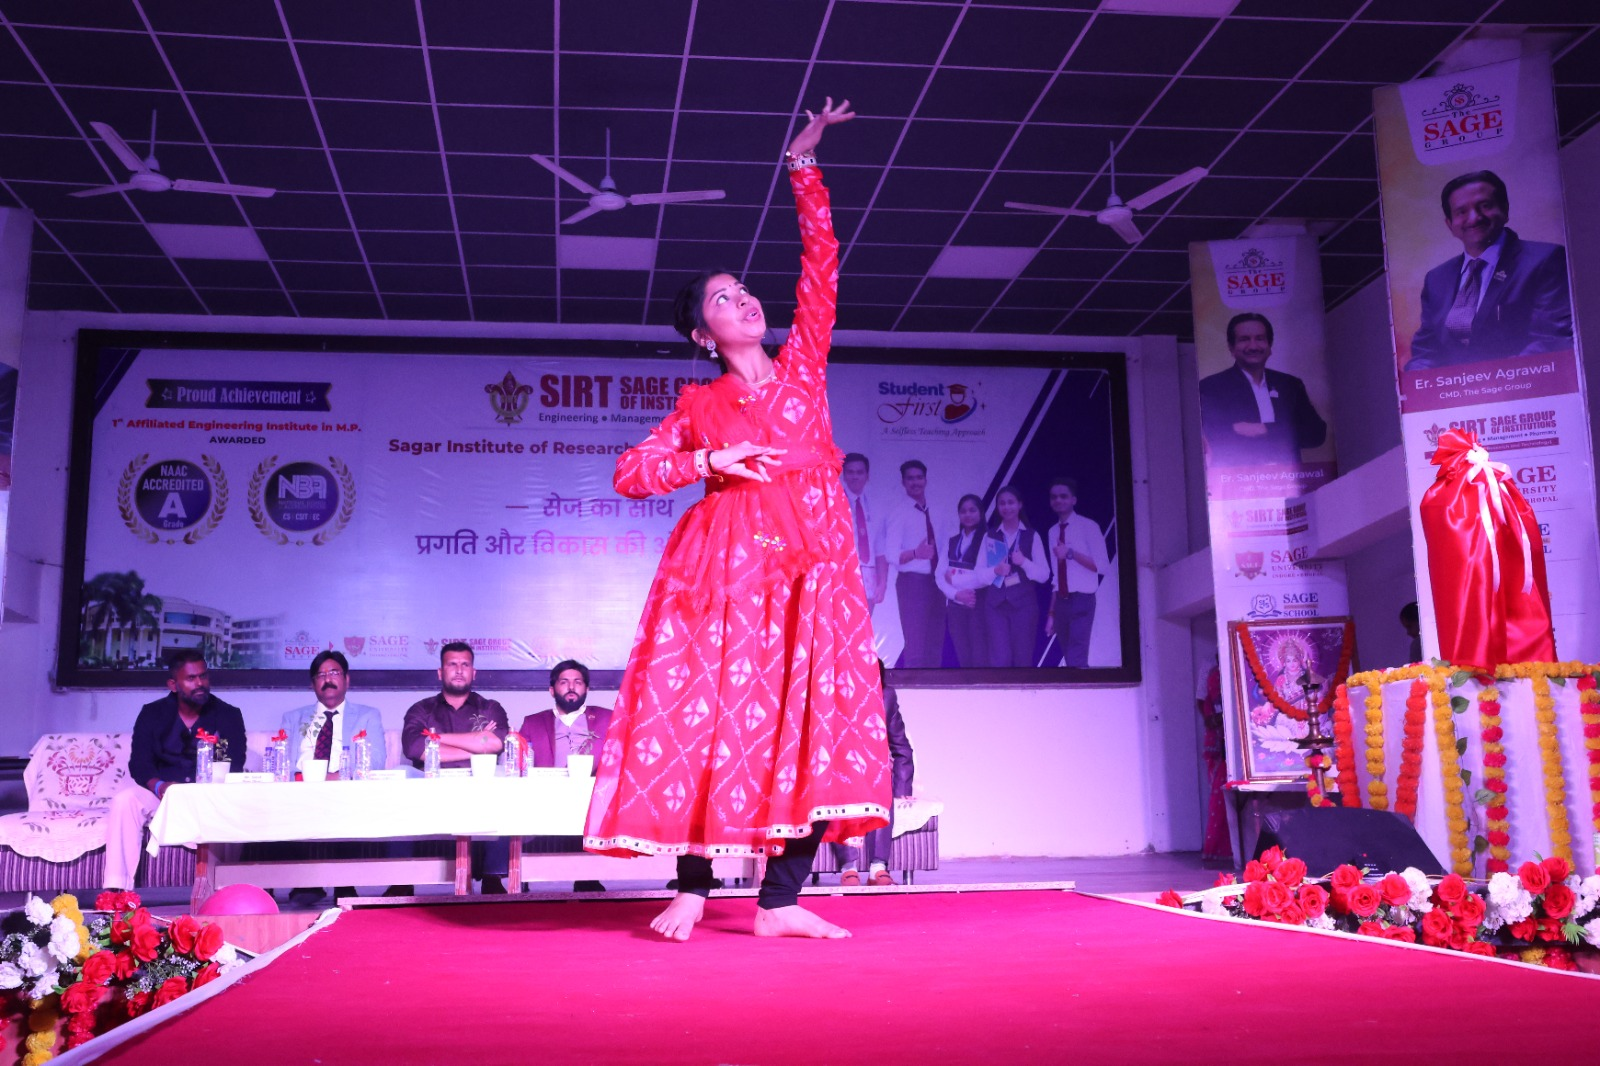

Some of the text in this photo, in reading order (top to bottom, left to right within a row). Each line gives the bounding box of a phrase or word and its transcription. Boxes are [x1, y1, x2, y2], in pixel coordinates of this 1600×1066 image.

[1451, 110, 1471, 118] The
[1424, 110, 1502, 141] SAGE
[1424, 128, 1503, 149] GROUP
[1227, 272, 1285, 289] SAGE
[1227, 286, 1286, 295] GROUP
[1415, 361, 1555, 390] Er. Sanjeev Agrawal
[176, 386, 301, 405] Proud Achievement
[540, 374, 613, 408] SIRT
[620, 376, 669, 395] SAGE
[878, 381, 945, 396] Student
[1439, 382, 1532, 399] CMD, The Sage Group
[620, 395, 637, 410] OF
[877, 396, 942, 424] First
[126, 419, 185, 430] Affiliated
[188, 420, 263, 432] Engineering
[266, 421, 318, 431] Institute
[322, 422, 333, 431] in
[336, 423, 362, 432] M.P.
[539, 413, 666, 425] Engineering Manageme
[1491, 414, 1517, 427] SAGE
[1519, 410, 1556, 423] GROUP
[1491, 420, 1557, 434] OF INSTITUTIONS
[209, 436, 266, 445] AWARDED
[388, 438, 634, 456] Sagar Institute of Research
[159, 465, 188, 477] NAAC
[1221, 469, 1324, 483] Er. Sanjeev Agrawal
[1516, 465, 1557, 484] GE
[142, 478, 204, 492] ACCREDITED
[278, 474, 327, 499] NBA
[1522, 485, 1557, 495] RSITY
[158, 492, 188, 518] A
[543, 492, 674, 518] सेज का साथ
[1246, 509, 1274, 522] SIRT
[163, 519, 184, 529] Grade
[415, 528, 479, 555] प्रगति
[485, 528, 527, 555] और
[531, 529, 610, 556] विकास
[615, 529, 647, 556] की
[1270, 546, 1309, 563] SAGE
[1283, 592, 1319, 604] SAGE
[1283, 609, 1320, 617] SCHOOL
[369, 635, 409, 645] SAGE
[285, 646, 320, 655] SAGE
